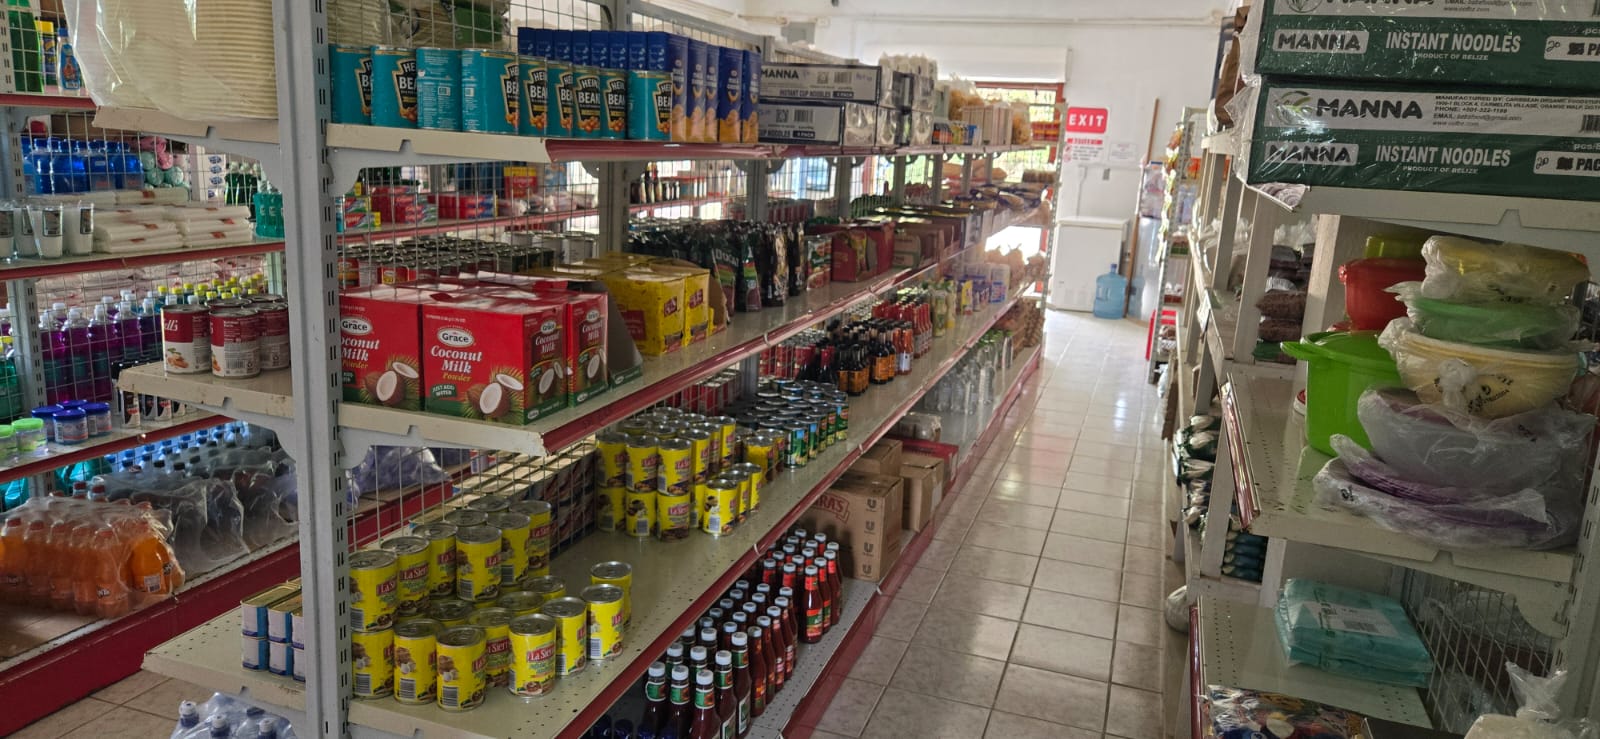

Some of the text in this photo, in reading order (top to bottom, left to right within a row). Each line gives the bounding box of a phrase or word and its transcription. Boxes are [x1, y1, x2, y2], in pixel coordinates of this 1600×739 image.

[1277, 33, 1361, 50] MANNA
[1385, 31, 1521, 52] INSTANT NOODLES
[761, 68, 799, 79] MANNA
[1316, 97, 1423, 119] MANNA
[1068, 113, 1104, 127] EXIT
[1269, 144, 1351, 163] MANNA
[1375, 144, 1511, 167] INSTANT NOODLES
[1402, 165, 1438, 173] PRODUCT
[342, 320, 368, 331] Grace
[442, 333, 469, 343] Grace
[342, 347, 369, 361] Milk
[431, 345, 483, 362] Coconut
[441, 359, 472, 374] Milk
[442, 372, 473, 382] Powder
